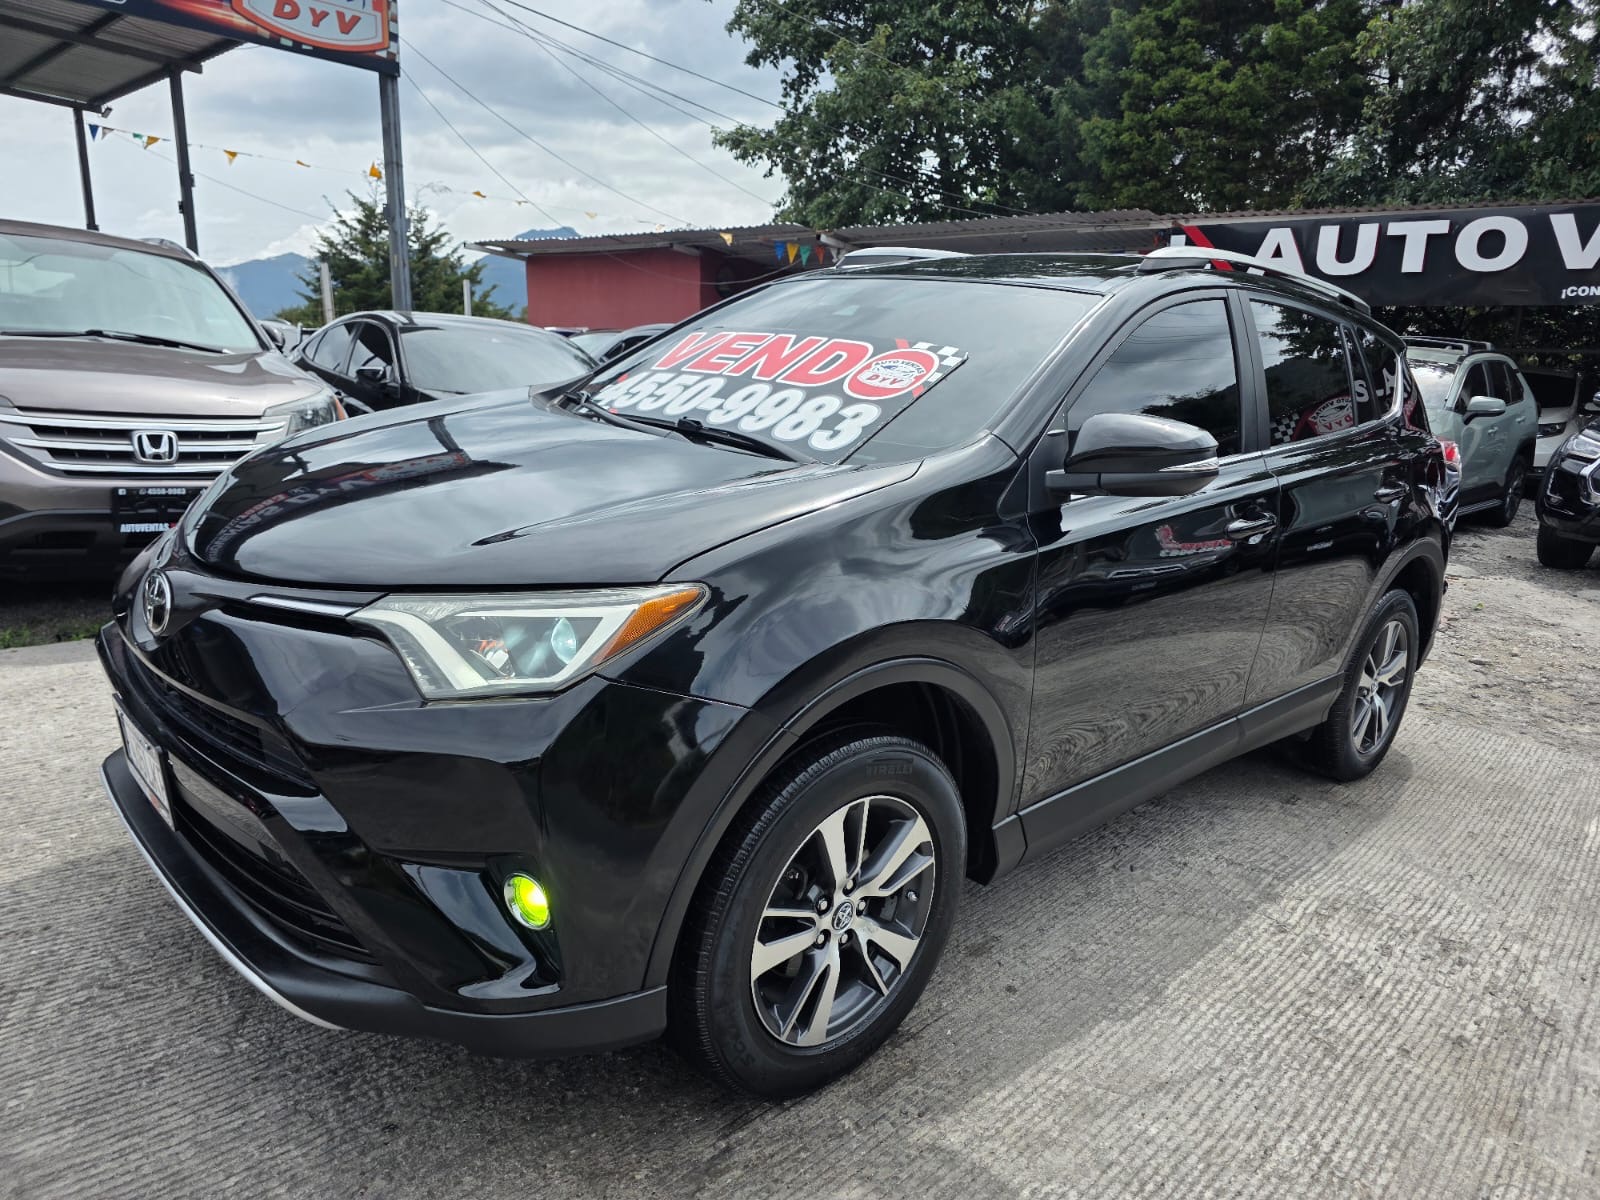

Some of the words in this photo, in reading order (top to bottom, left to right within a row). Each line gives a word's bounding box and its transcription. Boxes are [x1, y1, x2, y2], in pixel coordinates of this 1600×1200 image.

[273, 0, 362, 35] DYV
[1247, 215, 1529, 277] AUTO
[866, 374, 904, 386] DYV
[595, 371, 882, 451] 4550-9983
